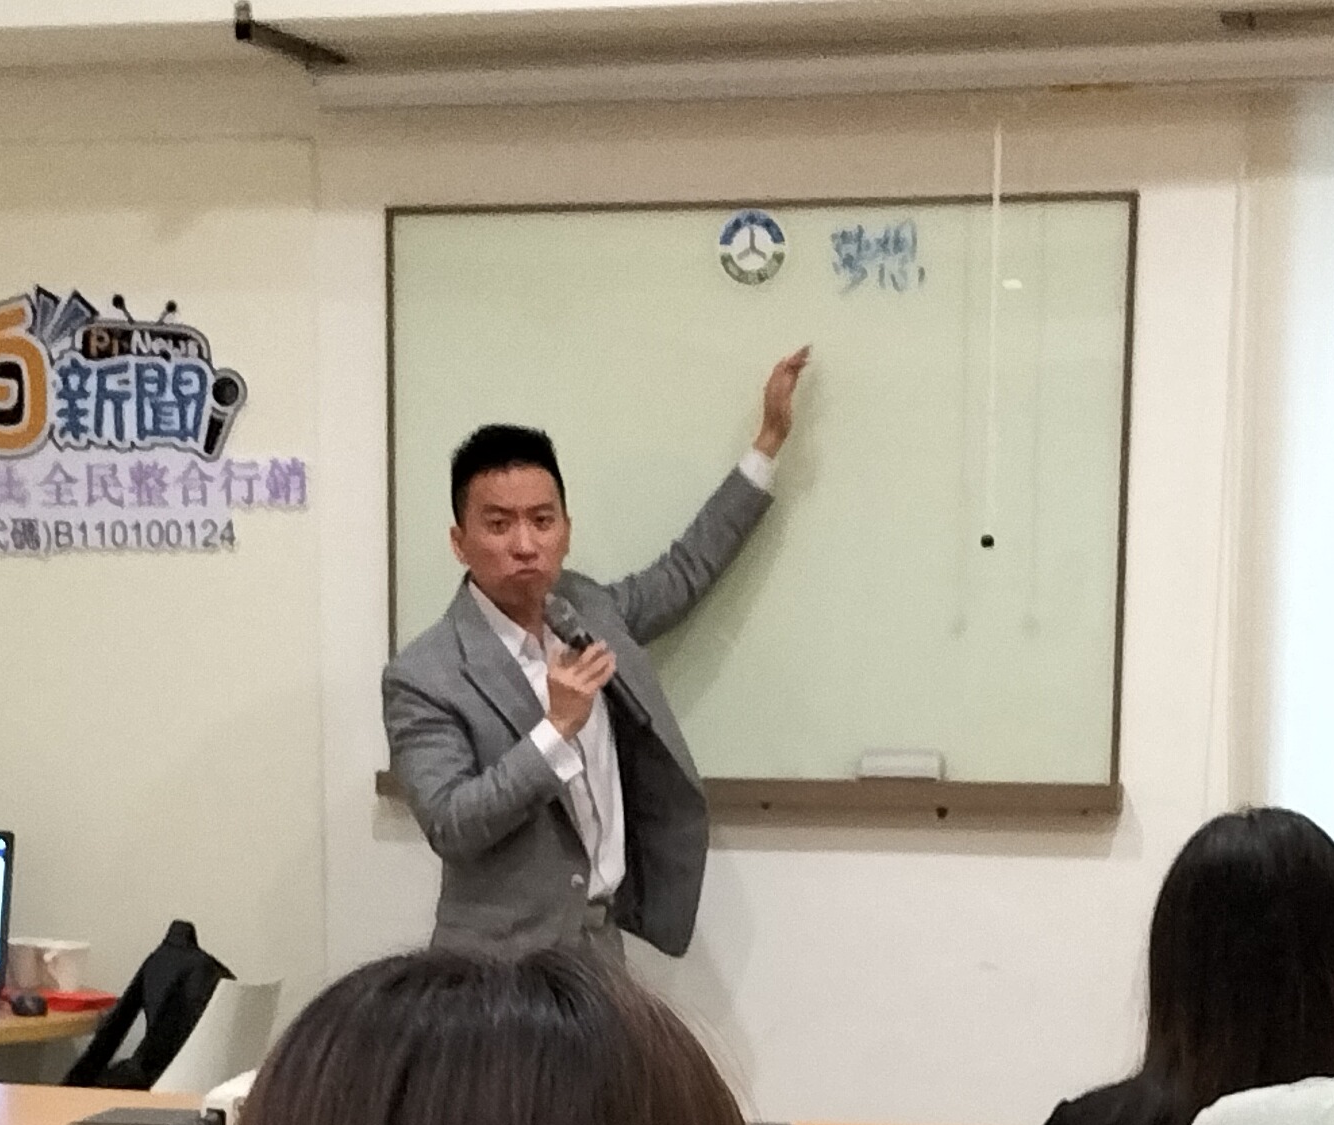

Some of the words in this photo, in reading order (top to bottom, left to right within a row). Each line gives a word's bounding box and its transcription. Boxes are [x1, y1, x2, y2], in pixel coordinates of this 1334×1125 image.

[38, 457, 308, 508] 全民整合行銷
